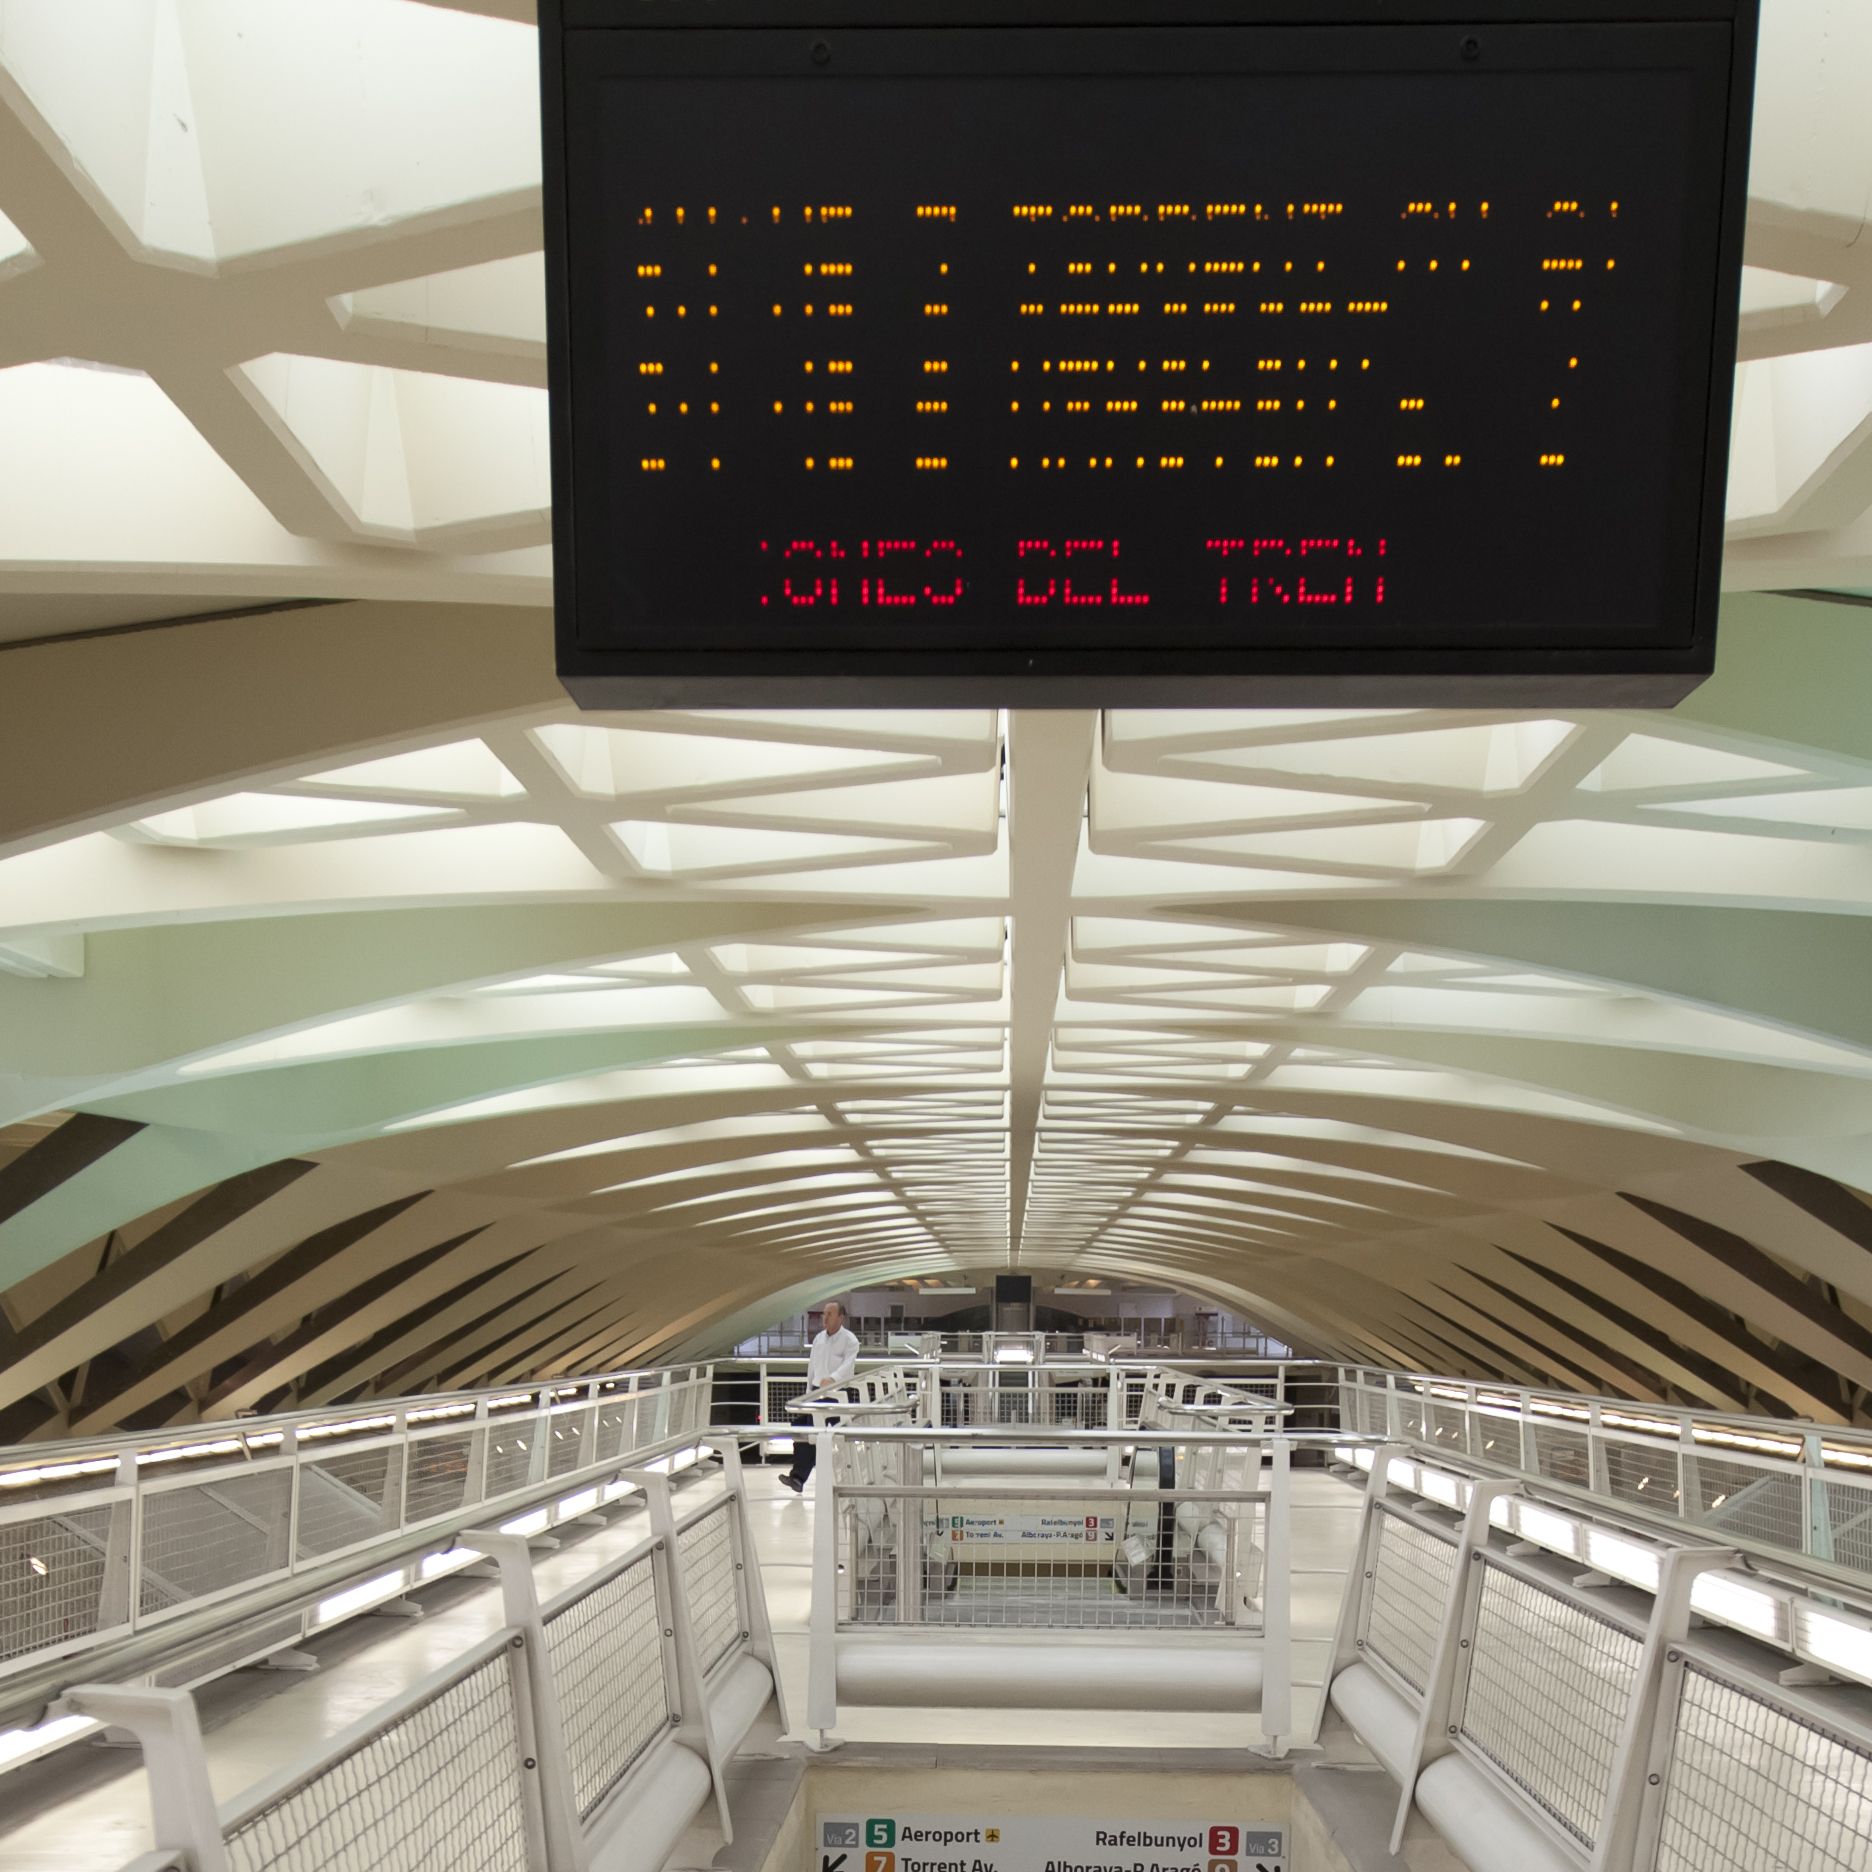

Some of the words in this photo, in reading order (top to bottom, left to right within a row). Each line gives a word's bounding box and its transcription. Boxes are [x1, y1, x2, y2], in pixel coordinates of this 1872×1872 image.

[845, 1828, 857, 1845] 2
[873, 1824, 888, 1844] 5
[901, 1826, 981, 1847] Aeroport
[1095, 1830, 1203, 1852] Rafelbunyol
[1215, 1830, 1231, 1852] 3
[1267, 1838, 1279, 1855] 3
